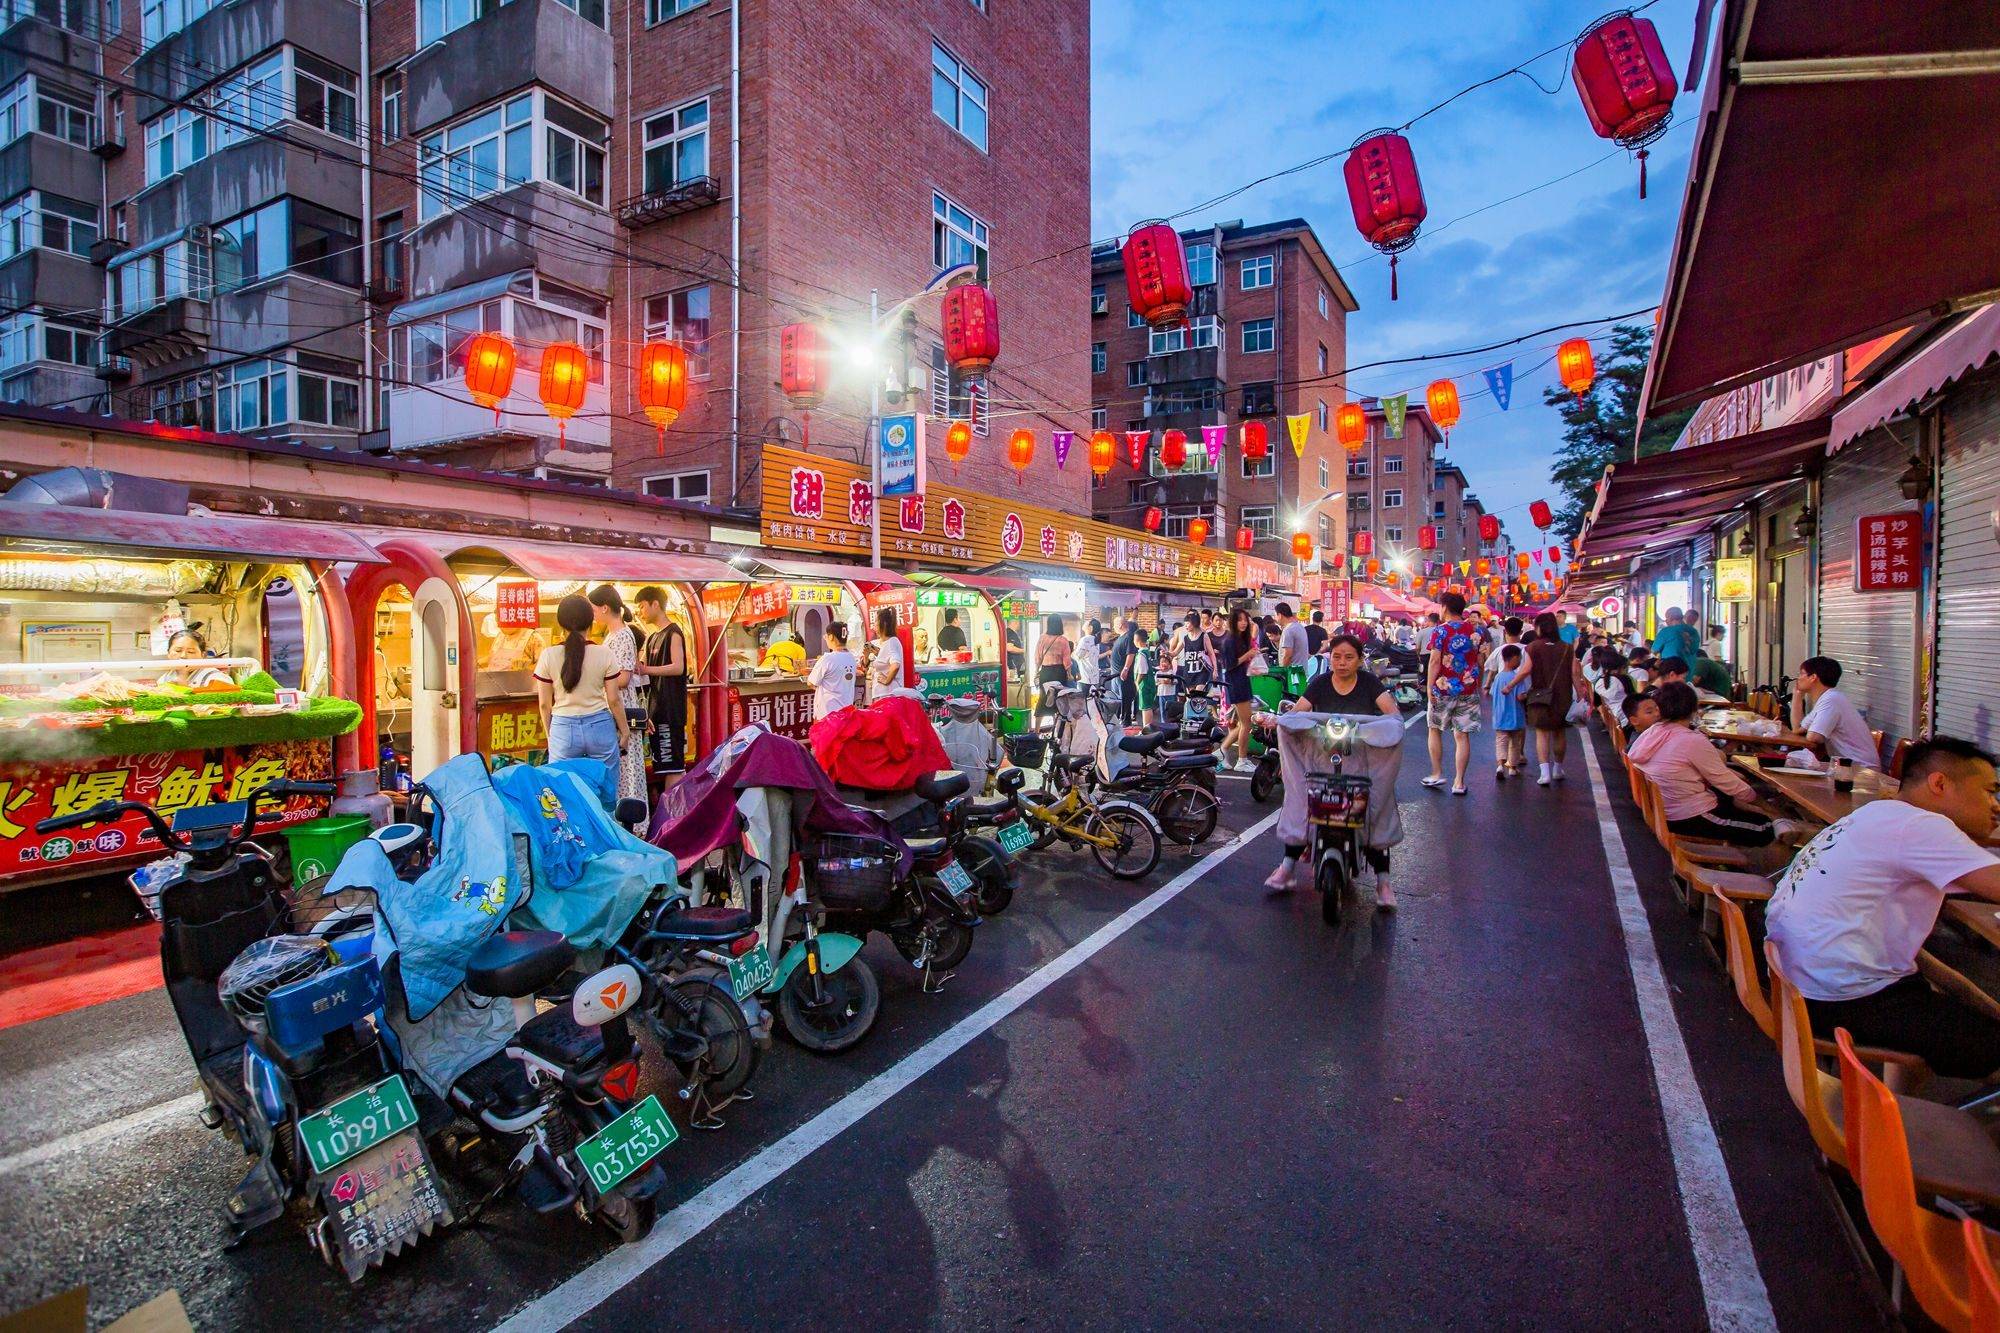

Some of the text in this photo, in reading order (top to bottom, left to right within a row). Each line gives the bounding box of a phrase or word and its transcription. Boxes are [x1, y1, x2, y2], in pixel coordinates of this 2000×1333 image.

[827, 529, 848, 546] 水饺
[1871, 521, 1888, 584] 骨汤麻辣烫
[1890, 519, 1909, 584] 炒芋头粉
[499, 588, 536, 605] 里脊肉饼
[499, 606, 537, 624] 脆皮年糕
[490, 711, 548, 750] 脆皮
[658, 723, 673, 764] MPMAN
[20, 832, 123, 862] 鱿滋鱿味
[735, 960, 772, 996] 040423
[316, 1100, 408, 1164] 109971
[592, 1118, 670, 1185] 037531
